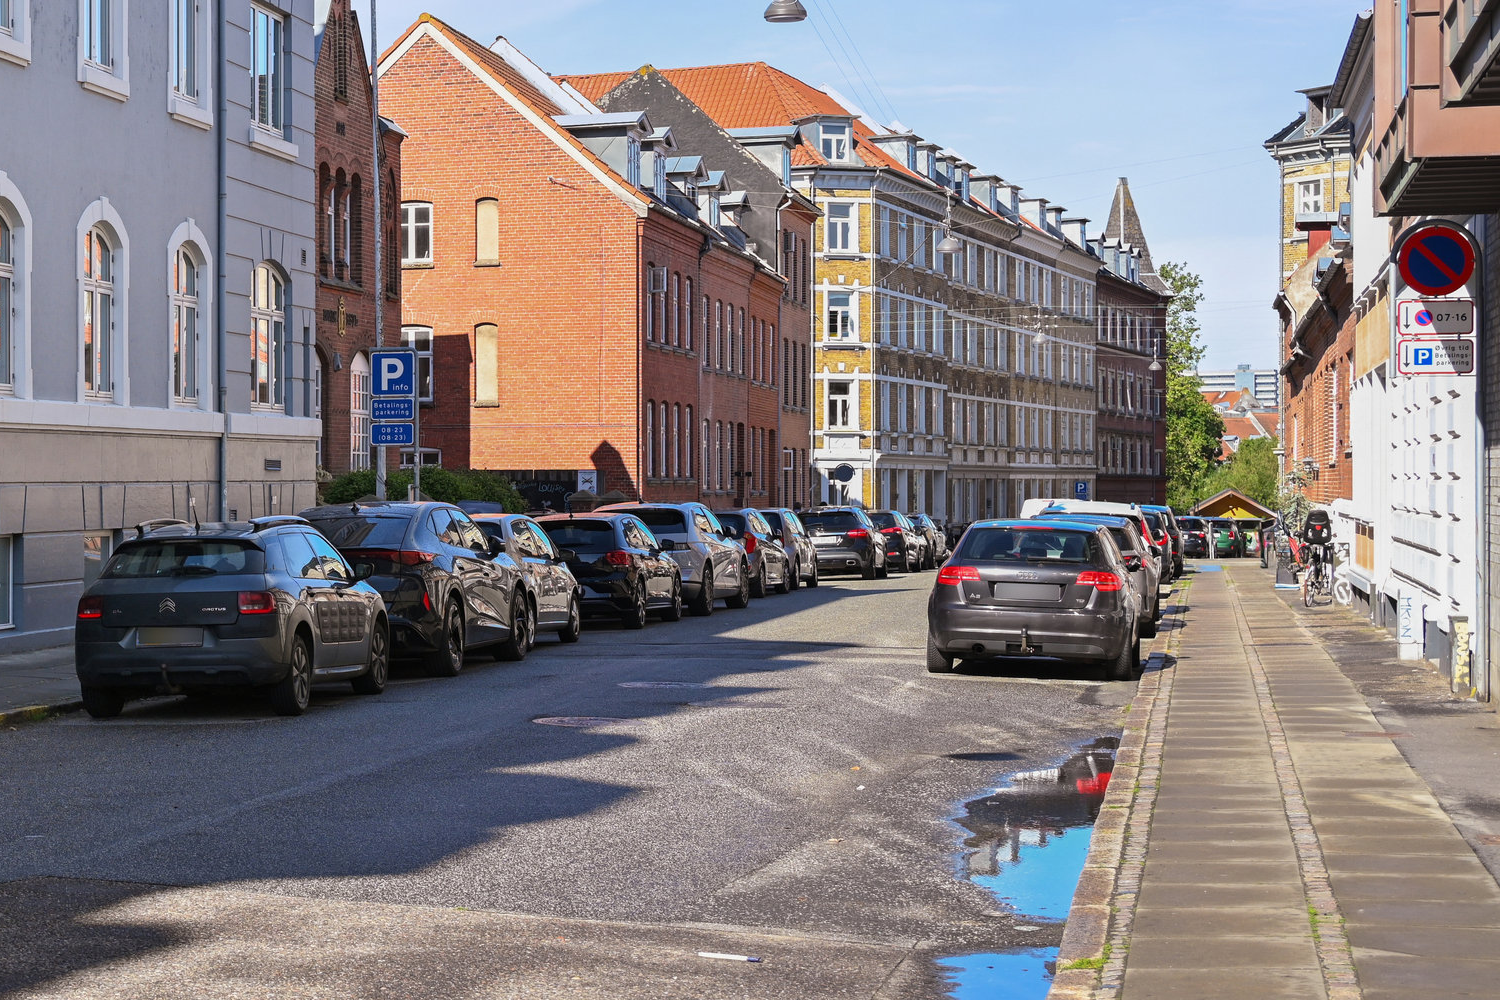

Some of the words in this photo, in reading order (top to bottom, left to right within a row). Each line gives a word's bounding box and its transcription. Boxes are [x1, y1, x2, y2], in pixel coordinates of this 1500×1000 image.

[1436, 313, 1468, 322] 07-16
[1417, 350, 1430, 364] P
[381, 357, 404, 391] P
[392, 383, 409, 391] info
[1077, 483, 1085, 493] P
